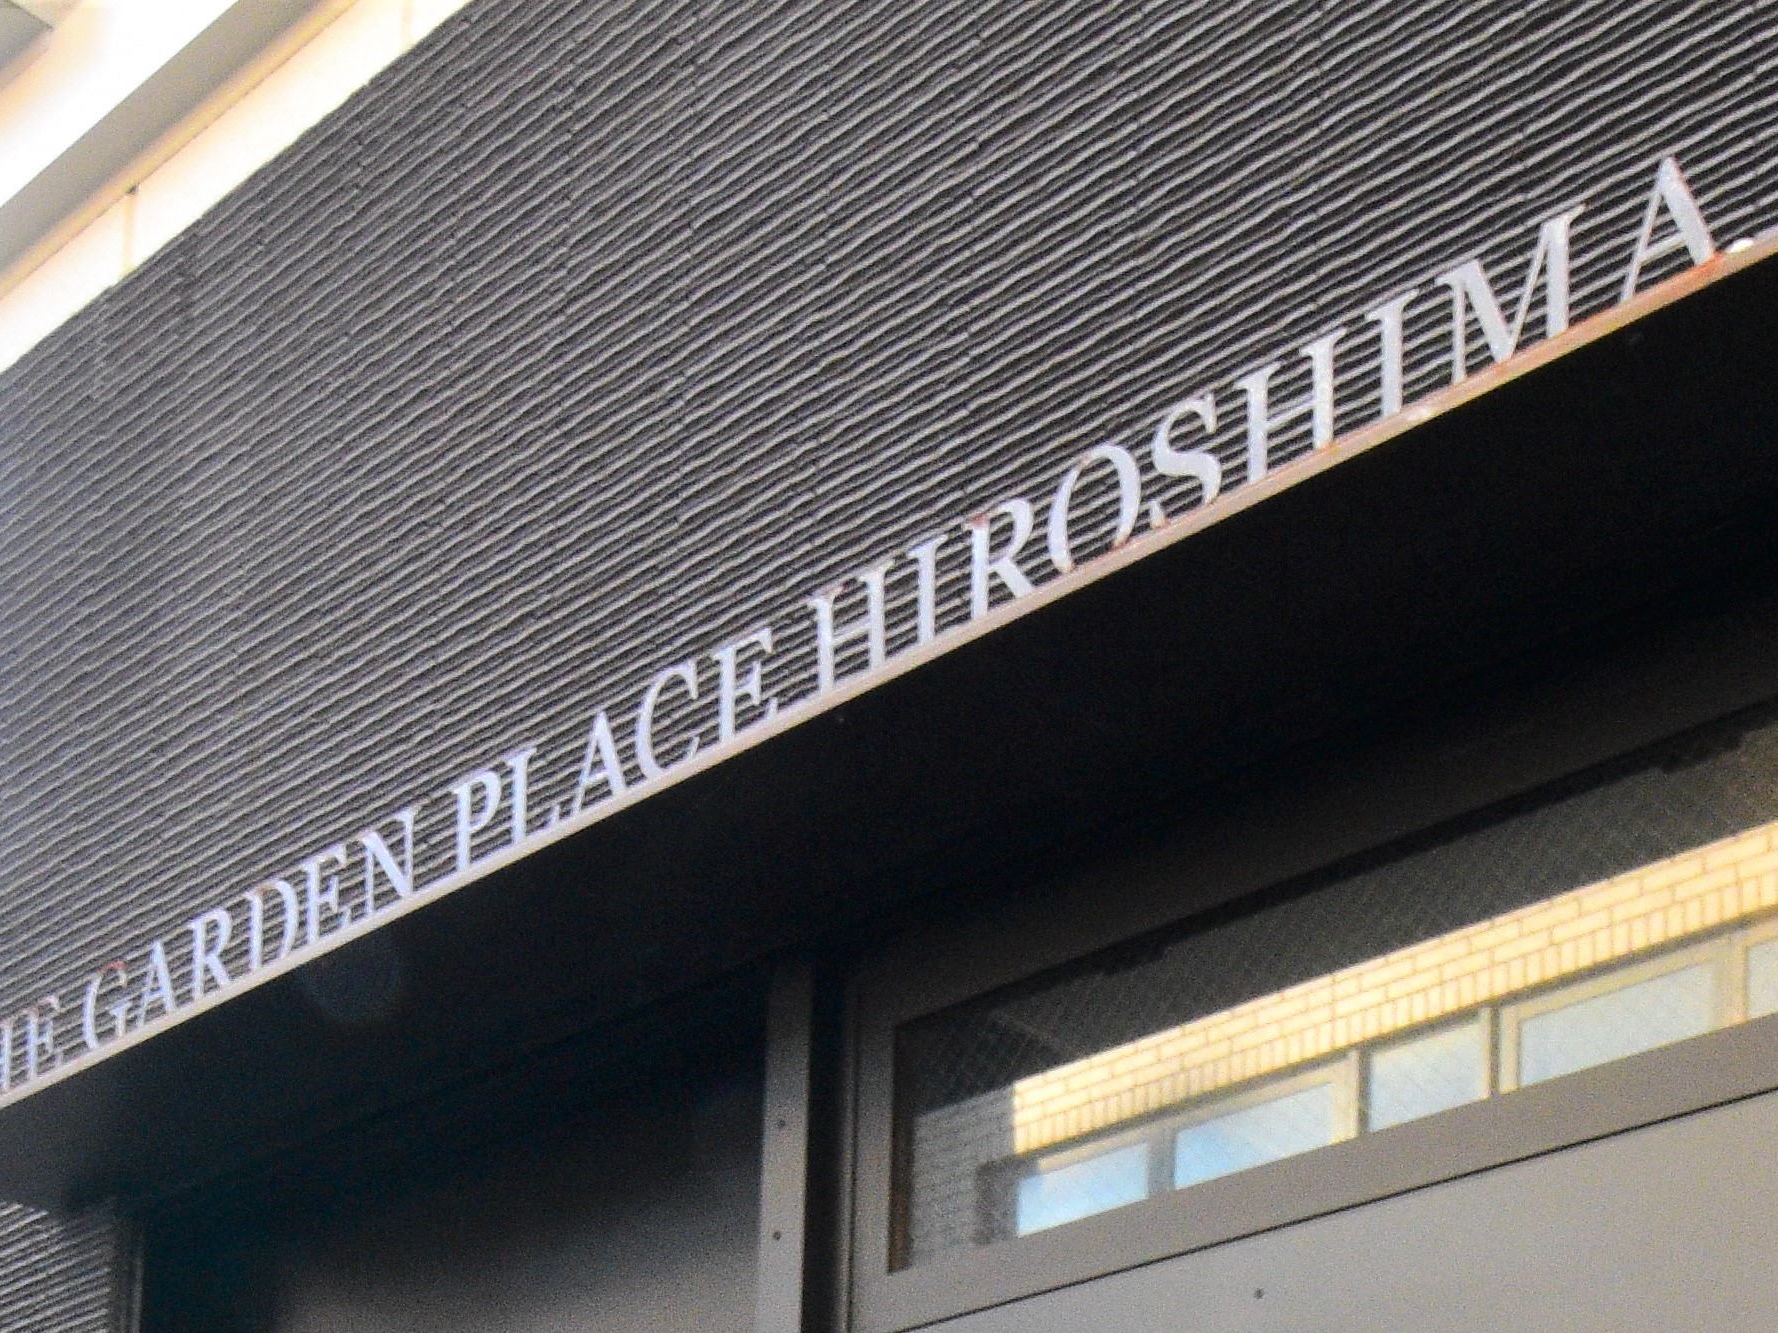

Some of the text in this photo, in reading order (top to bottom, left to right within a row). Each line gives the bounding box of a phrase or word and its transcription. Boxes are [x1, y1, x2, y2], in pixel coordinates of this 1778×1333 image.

[80, 806, 421, 1054] GARDEN
[451, 626, 779, 868] PLACE
[808, 156, 1718, 694] HIROSHIMA
